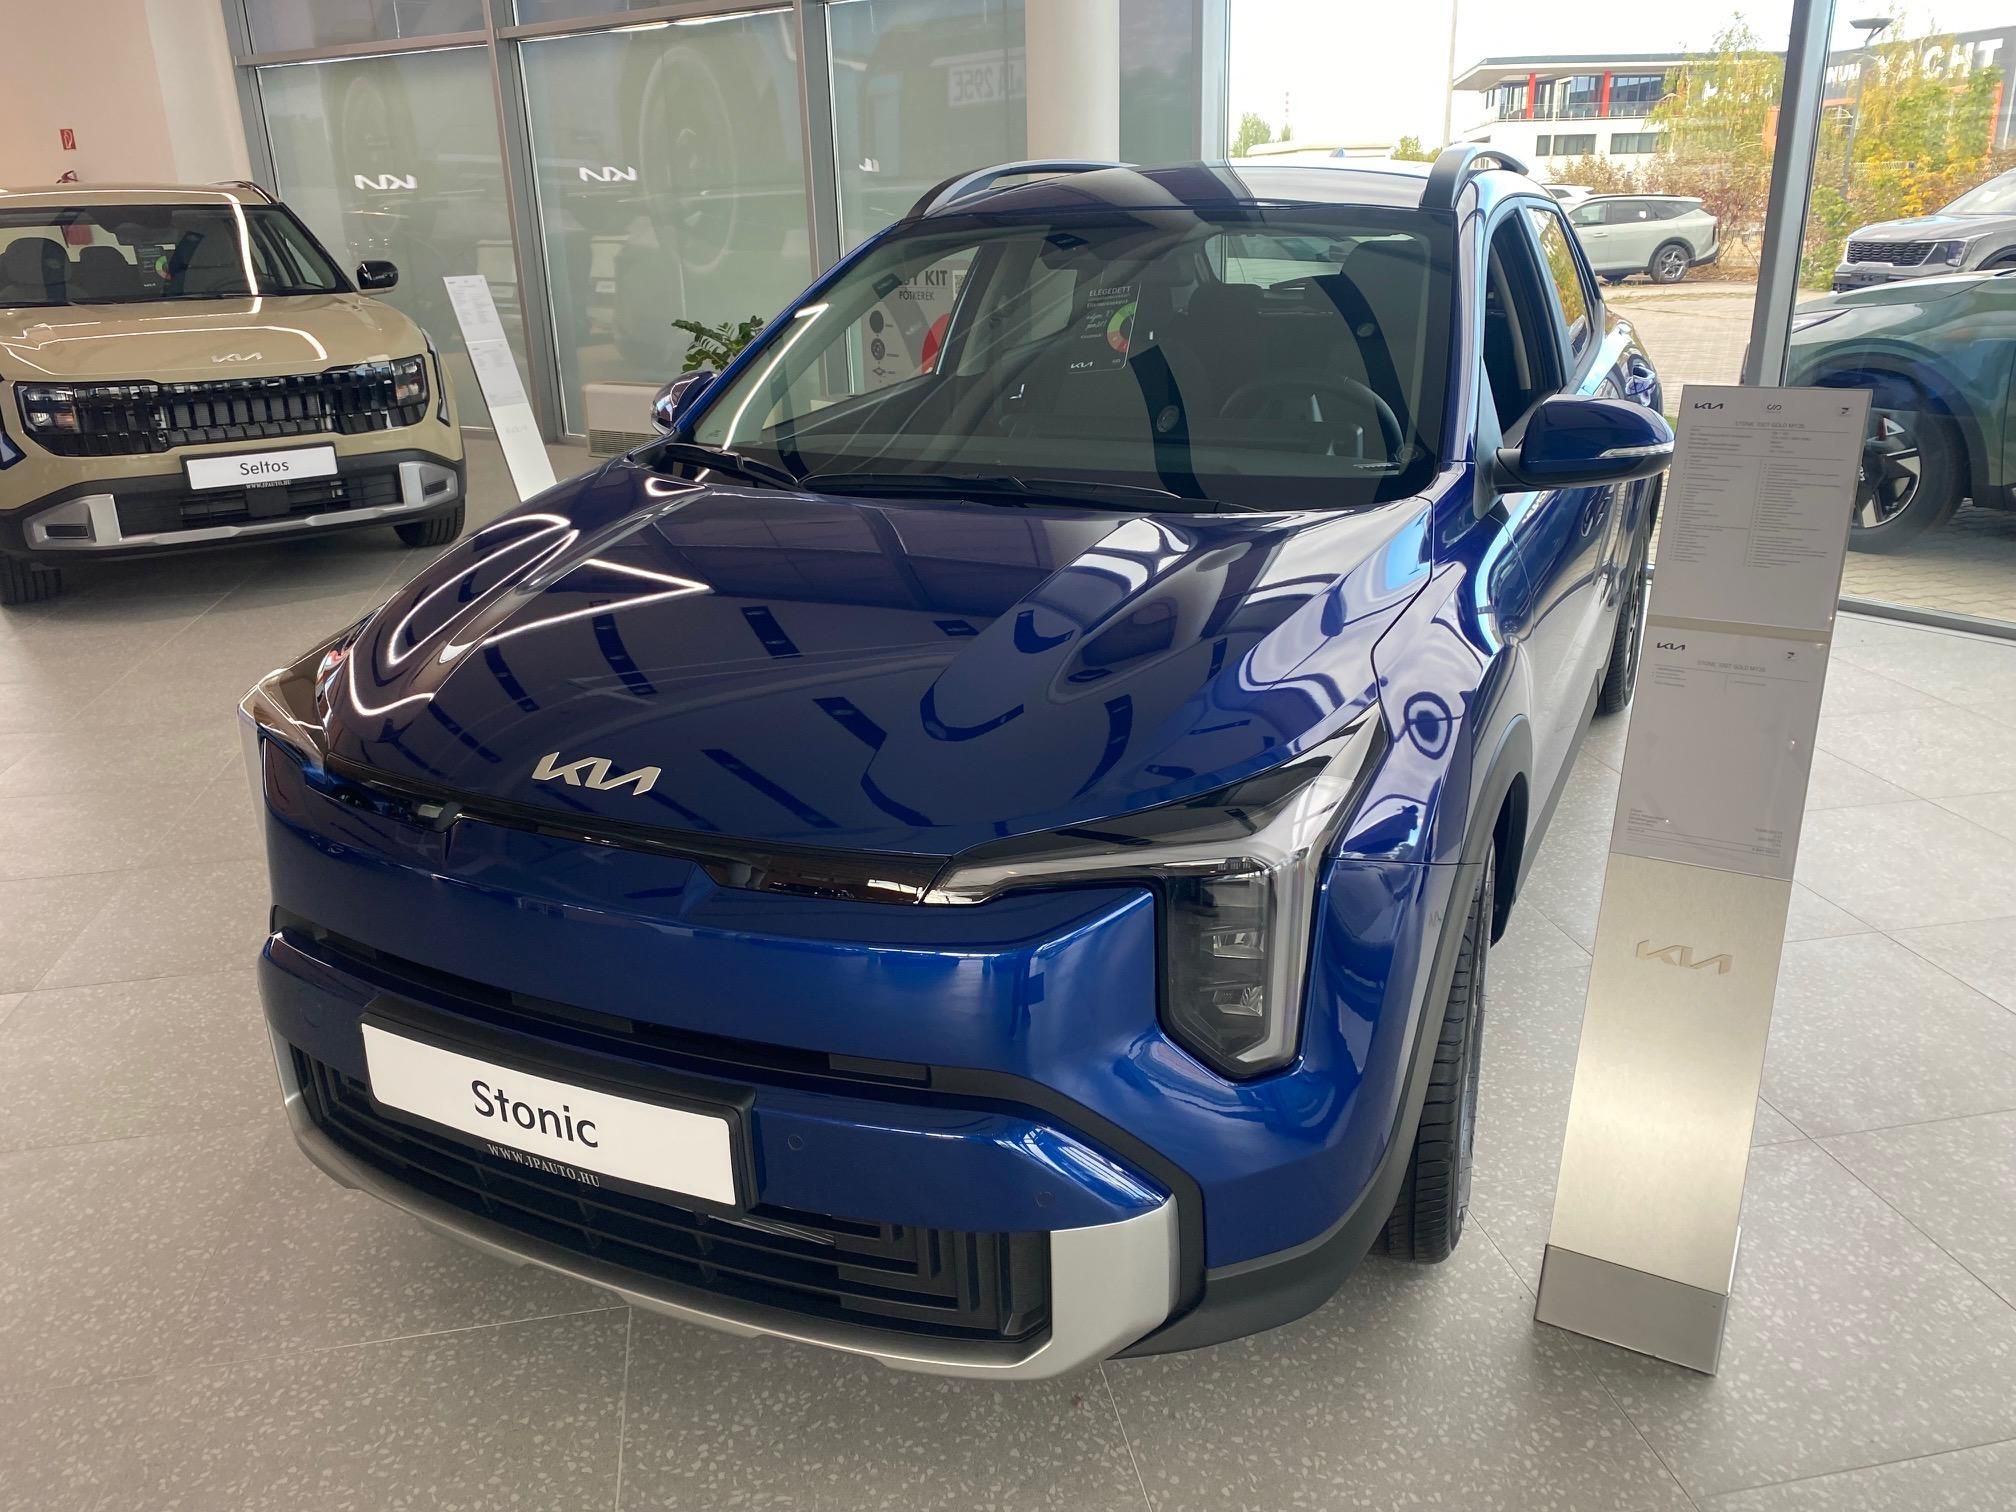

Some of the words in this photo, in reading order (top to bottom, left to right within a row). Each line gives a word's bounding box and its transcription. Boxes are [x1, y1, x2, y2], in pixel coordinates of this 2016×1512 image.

[925, 270, 948, 286] KIT
[1070, 361, 1095, 369] KIA
[1694, 402, 1724, 410] KIA
[239, 461, 290, 476] Seltos
[1656, 641, 1686, 651] KIA
[531, 751, 661, 795] KIA
[1635, 938, 1733, 975] KIA
[471, 1080, 599, 1148] Stonic
[486, 1143, 600, 1188] WWW.JPAUTO.HU
